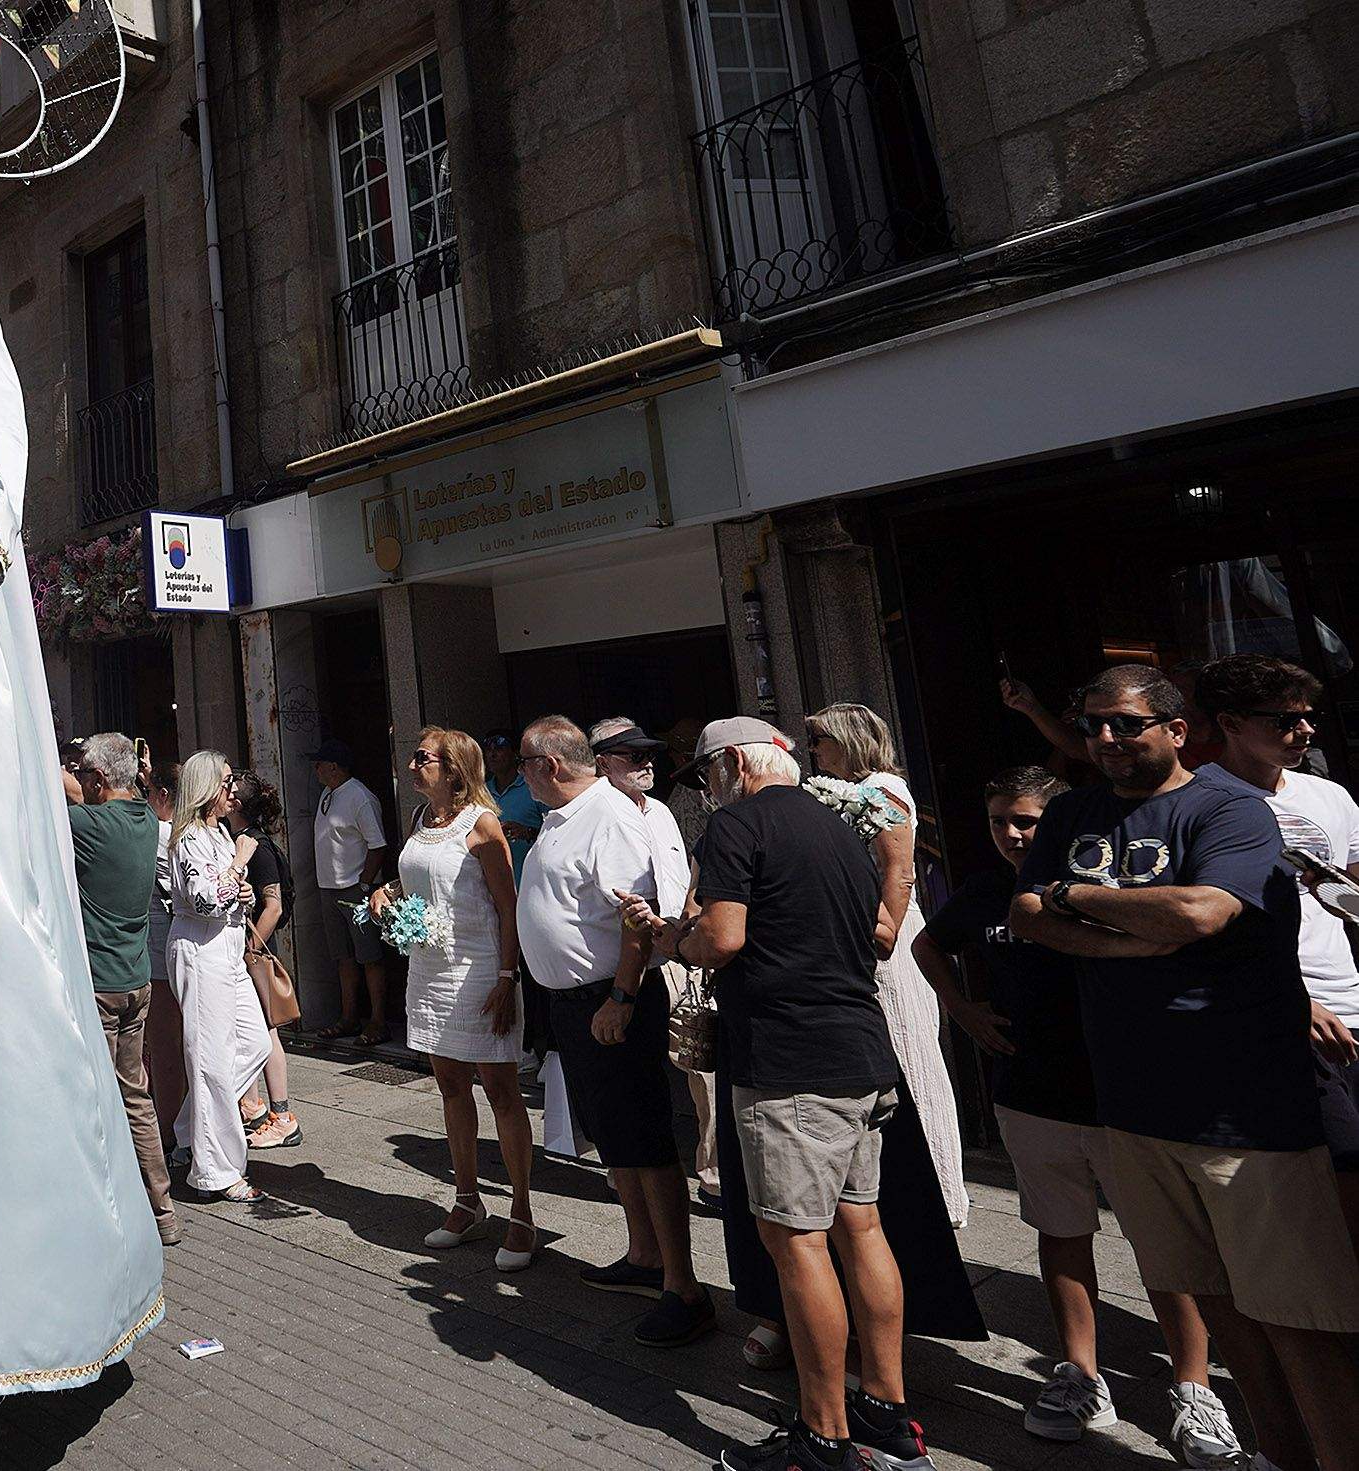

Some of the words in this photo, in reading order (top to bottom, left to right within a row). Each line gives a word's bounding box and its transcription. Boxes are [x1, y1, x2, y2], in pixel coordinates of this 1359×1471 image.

[413, 472, 497, 511] Loterías
[502, 466, 516, 494] y
[416, 501, 512, 545] Apuestas
[518, 485, 553, 518] del
[559, 466, 647, 508] Estado
[479, 542, 492, 553] La
[493, 537, 515, 549] Uno
[531, 513, 617, 541] Administración
[166, 582, 200, 592] Apuestas
[202, 583, 213, 593] del
[196, 574, 201, 583] y
[166, 593, 192, 602] Estado
